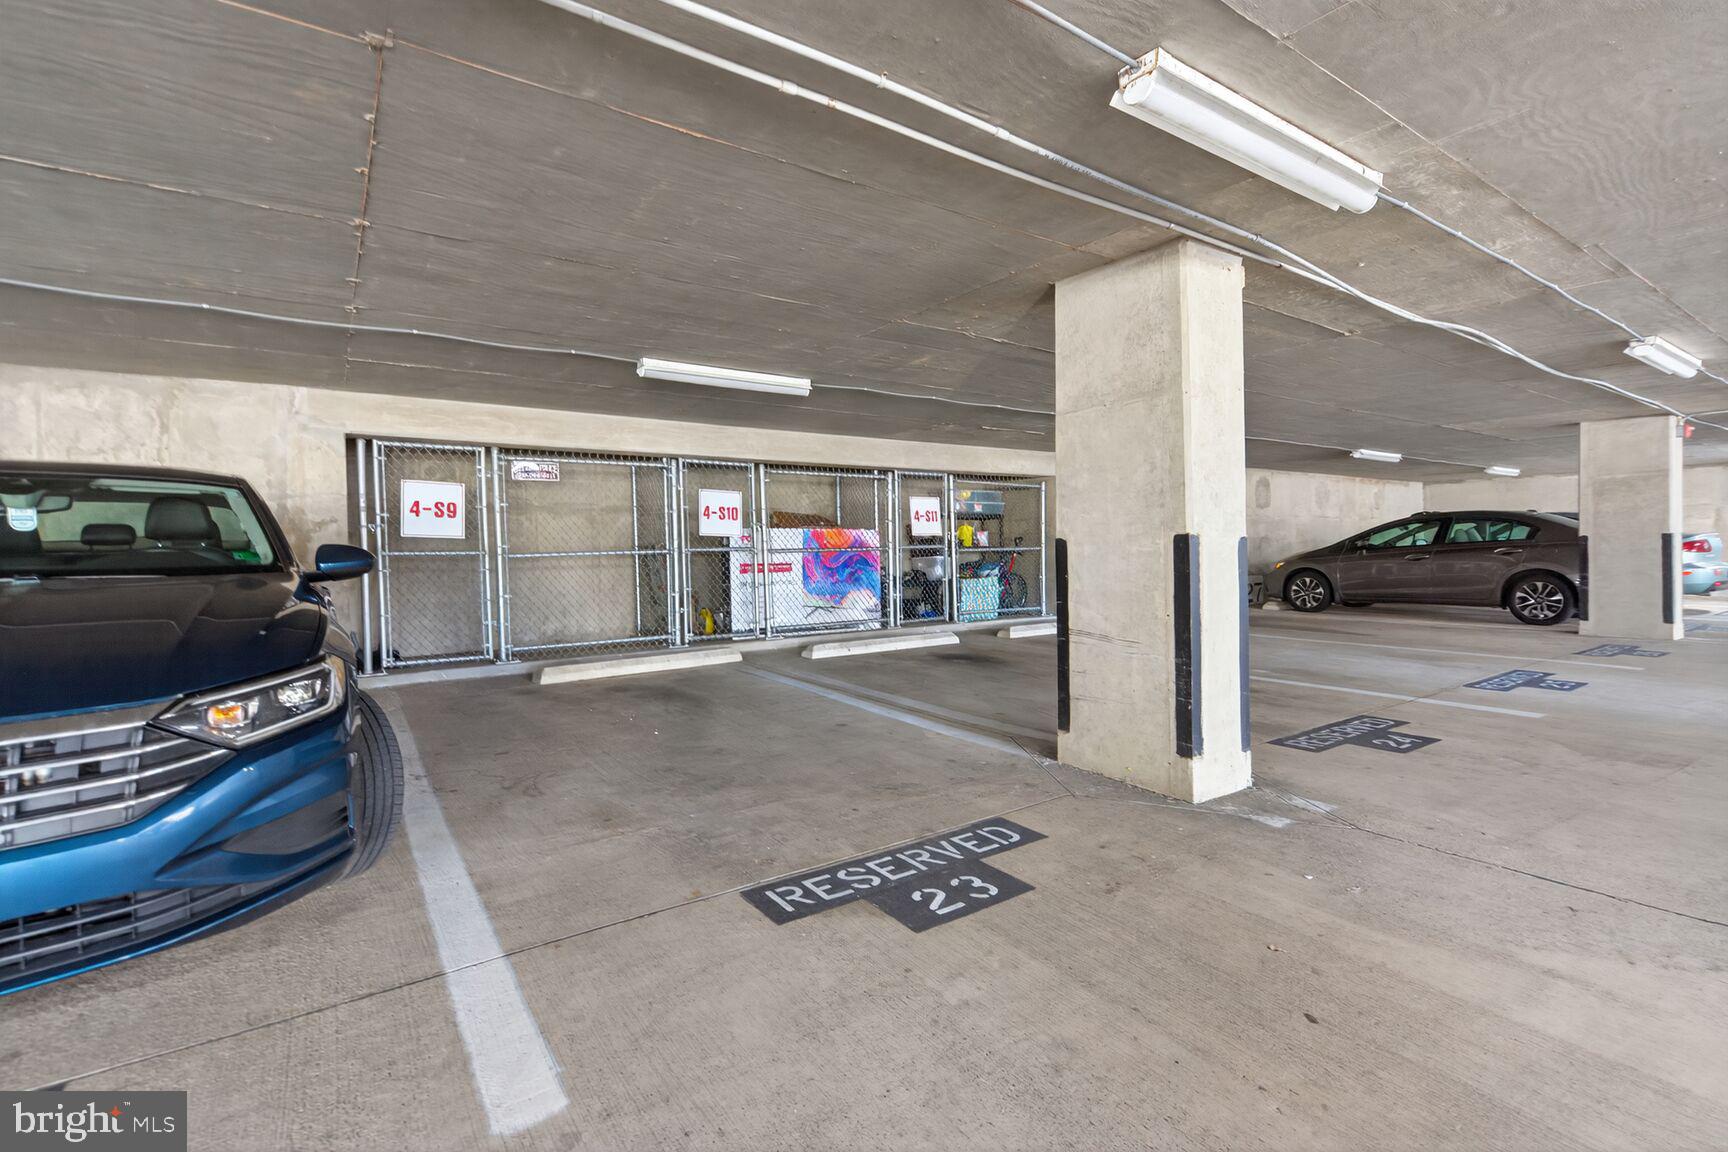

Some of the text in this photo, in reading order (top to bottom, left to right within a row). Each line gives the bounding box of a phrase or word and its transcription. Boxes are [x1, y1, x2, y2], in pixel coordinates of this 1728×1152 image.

[409, 500, 457, 519] 4-S9
[703, 505, 739, 521] 4-S10
[914, 510, 939, 522] 4-S11
[1371, 734, 1423, 750] 24
[764, 826, 1021, 912] RESERVED
[911, 875, 999, 915] 23
